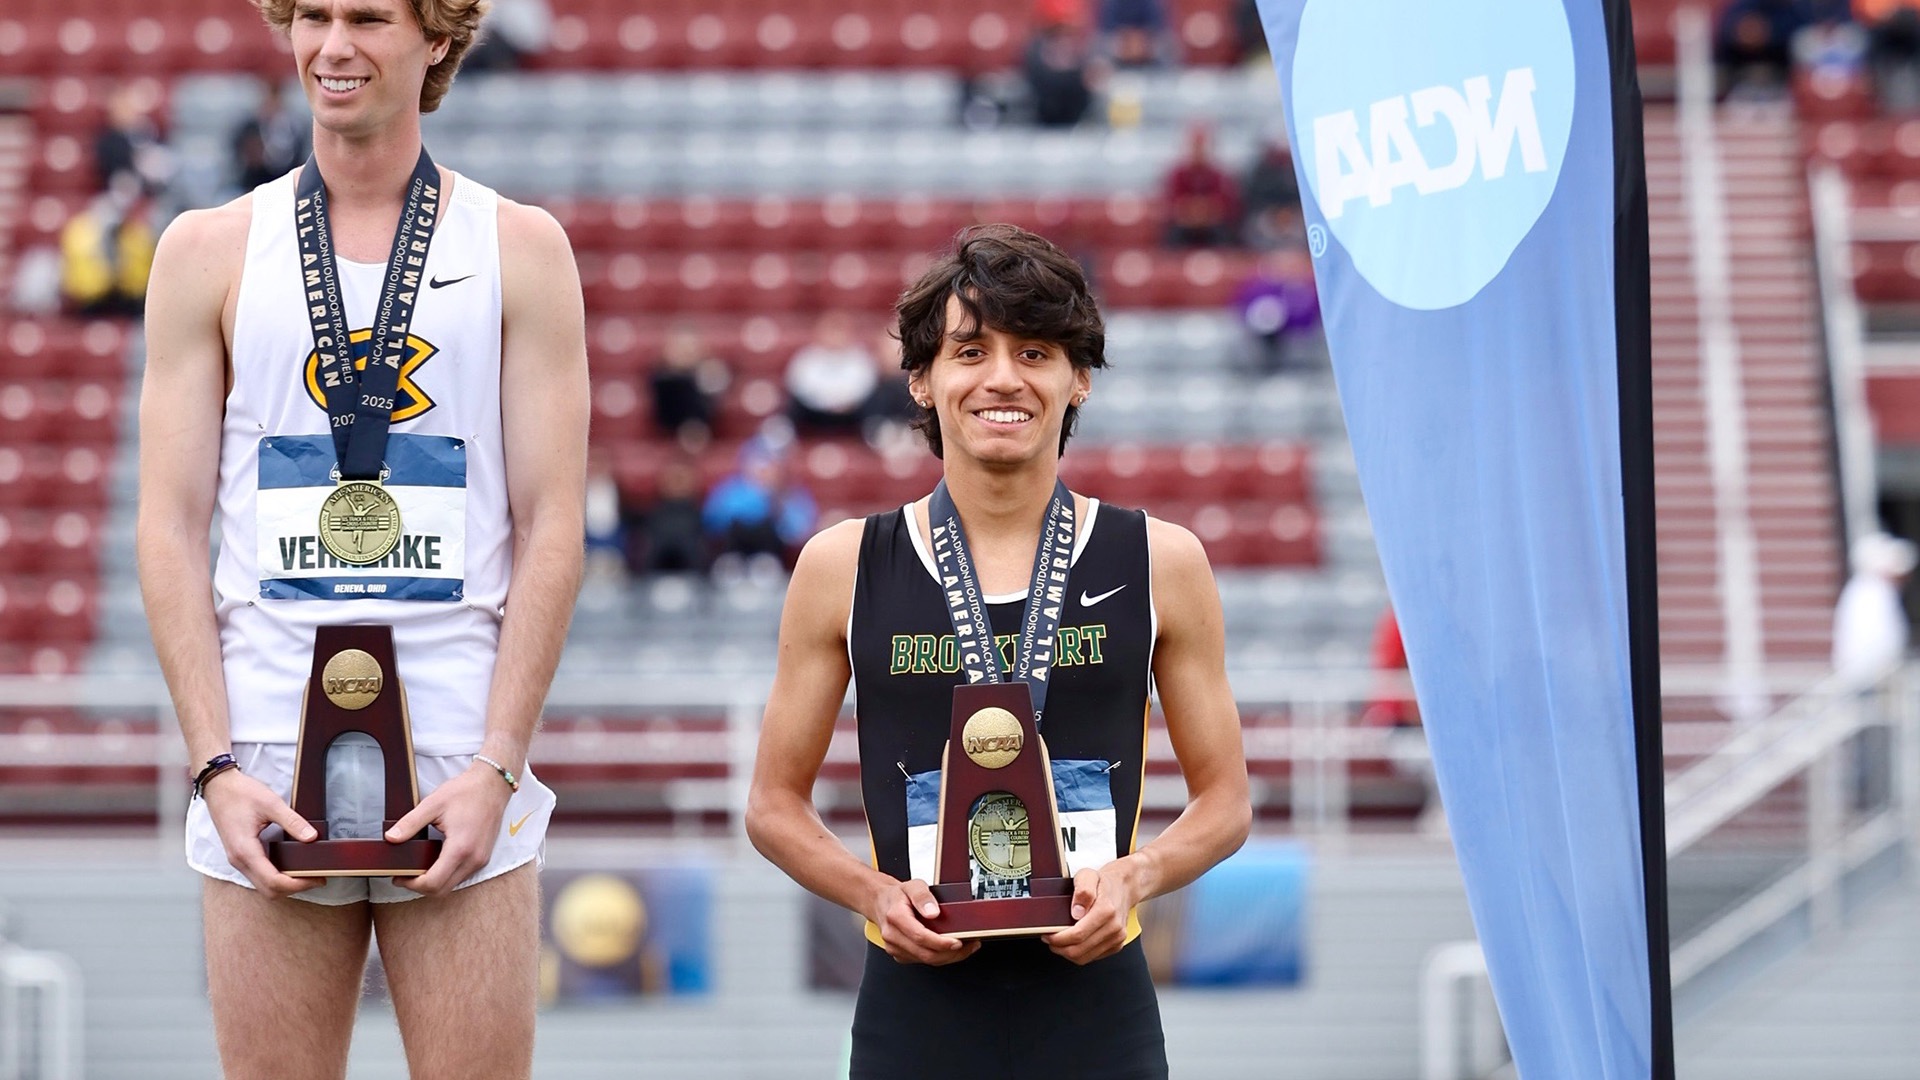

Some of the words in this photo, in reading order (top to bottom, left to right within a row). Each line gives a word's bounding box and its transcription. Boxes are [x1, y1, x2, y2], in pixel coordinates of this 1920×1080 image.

[313, 190, 323, 218] NCAA
[410, 178, 423, 202] FIELD
[401, 207, 416, 235] TRACK
[316, 217, 330, 257] DIVISION
[390, 234, 409, 282] OUTDOOR
[323, 267, 340, 317] OUTDOOR
[384, 184, 438, 370] ALL-AMERICAN
[297, 198, 341, 388] ALL-AMERICAN
[377, 291, 395, 336] DIVISION
[332, 317, 347, 349] TRACK
[371, 336, 385, 366] NCAA
[340, 357, 353, 384] FIELD
[361, 394, 394, 410] 2025
[332, 413, 356, 428] 202
[1050, 497, 1060, 520] FIELD
[1043, 524, 1055, 551] TRACK
[334, 584, 365, 593] GENEVA,
[367, 584, 387, 593] OHIO
[1034, 551, 1051, 597] OUTDOOR
[932, 526, 984, 684] ALL-AMERICA
[946, 516, 959, 542] NCAA
[953, 540, 971, 579] DIVISION
[966, 587, 987, 635] OUTDOOR
[979, 635, 994, 666] TRACK
[1031, 505, 1073, 682] ALL-AMERICAN
[1023, 606, 1039, 649] DIVISION
[890, 624, 1107, 675] BROKRT
[1018, 649, 1031, 678] NCAA
[327, 677, 381, 695] NCAA
[968, 734, 1023, 754] NCAA
